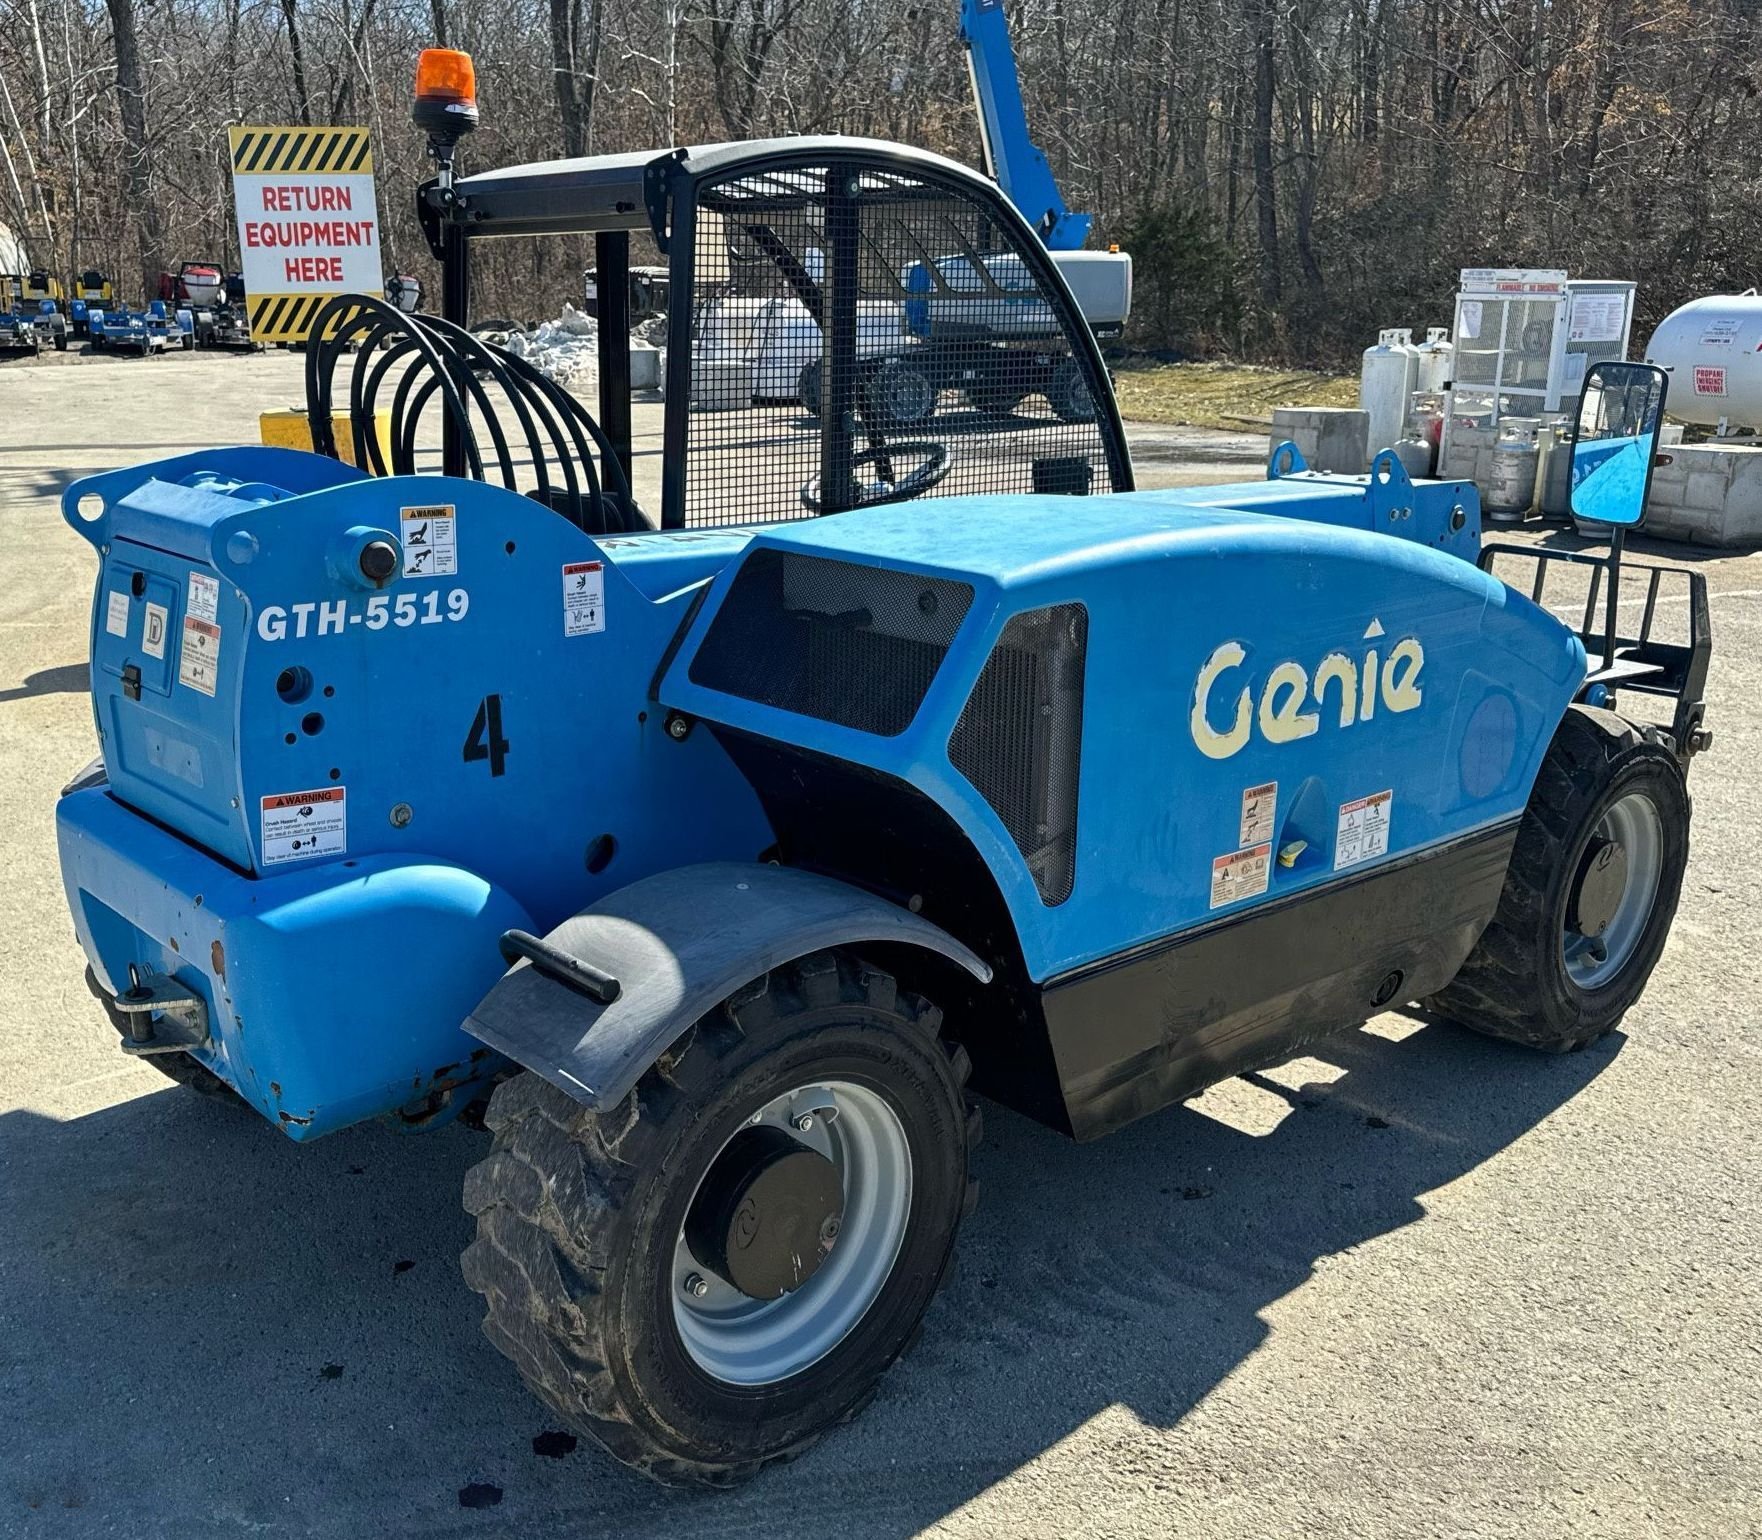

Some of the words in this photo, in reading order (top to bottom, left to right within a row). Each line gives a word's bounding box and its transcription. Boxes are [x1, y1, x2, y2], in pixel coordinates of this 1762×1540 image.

[262, 186, 352, 211] RETURN
[245, 221, 374, 248] EQUIPMENT
[284, 257, 344, 282] HERE
[1696, 369, 1724, 378] PROPANE
[416, 509, 447, 518] WARNING
[574, 563, 599, 573] WARNING
[257, 588, 470, 642] GTH-5519
[1190, 617, 1425, 760] Genie
[463, 694, 510, 777] 4
[285, 791, 332, 805] WARNING
